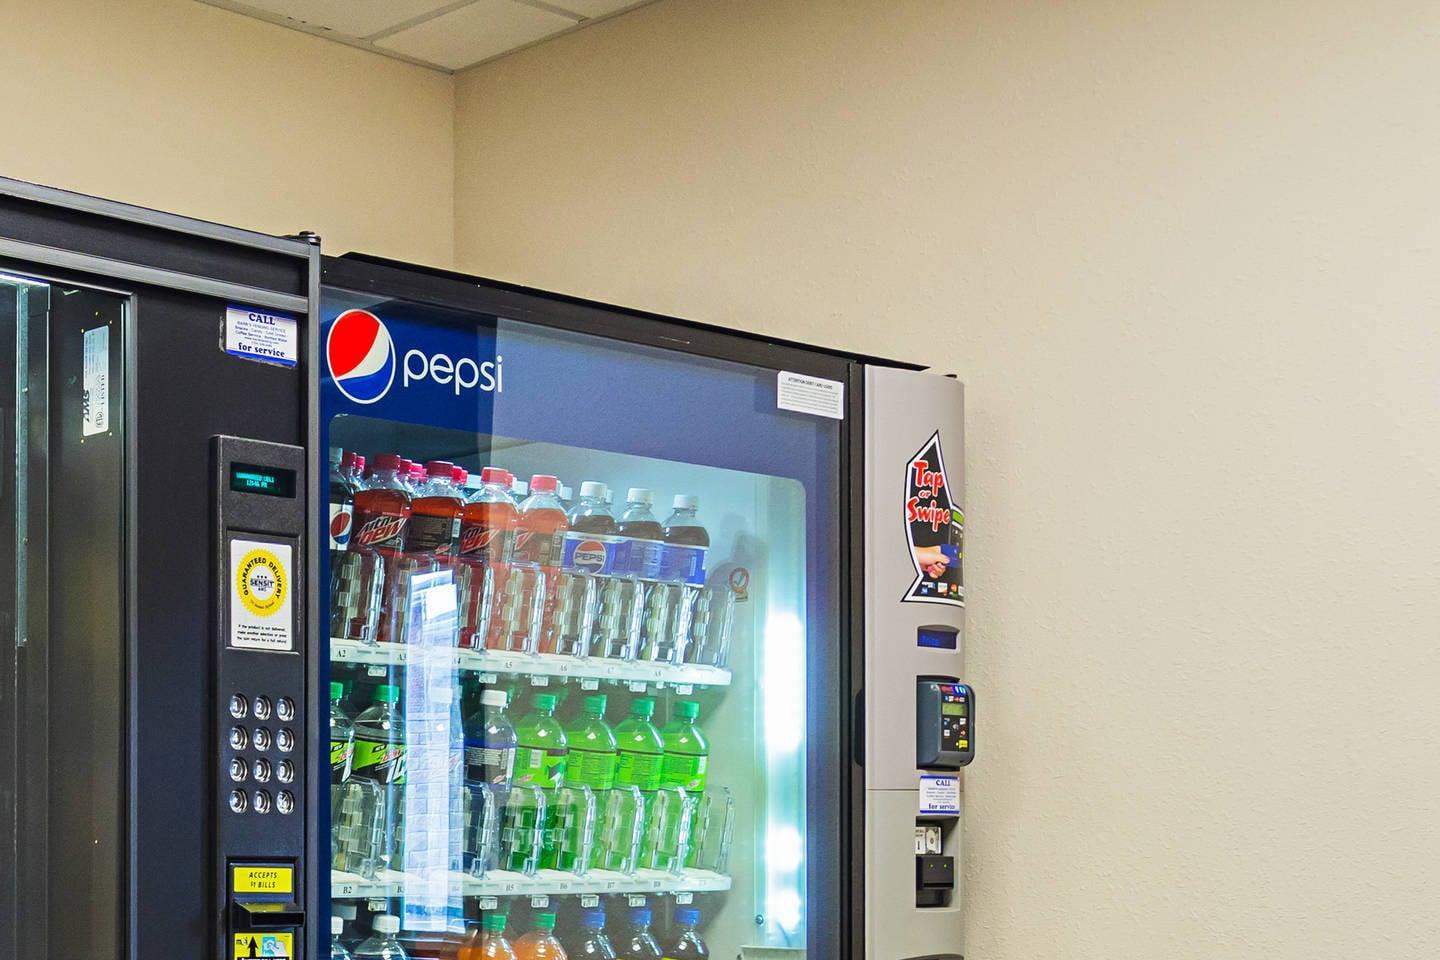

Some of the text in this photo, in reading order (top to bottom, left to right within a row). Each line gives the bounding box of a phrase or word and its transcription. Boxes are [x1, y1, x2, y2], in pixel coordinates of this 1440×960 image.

[248, 313, 276, 326] CALL
[238, 341, 252, 352] for
[254, 346, 285, 358] service
[403, 347, 503, 395] pepsi
[913, 459, 944, 497] Tap
[918, 489, 931, 499] or
[906, 496, 950, 532] Swipe
[574, 551, 605, 562] PEPSI
[241, 556, 282, 600] GUARANTEED DELIVERY
[935, 779, 951, 787] CALL
[248, 871, 278, 879] ACCEPTS
[257, 881, 276, 889] BILLS
[342, 885, 353, 894] B2
